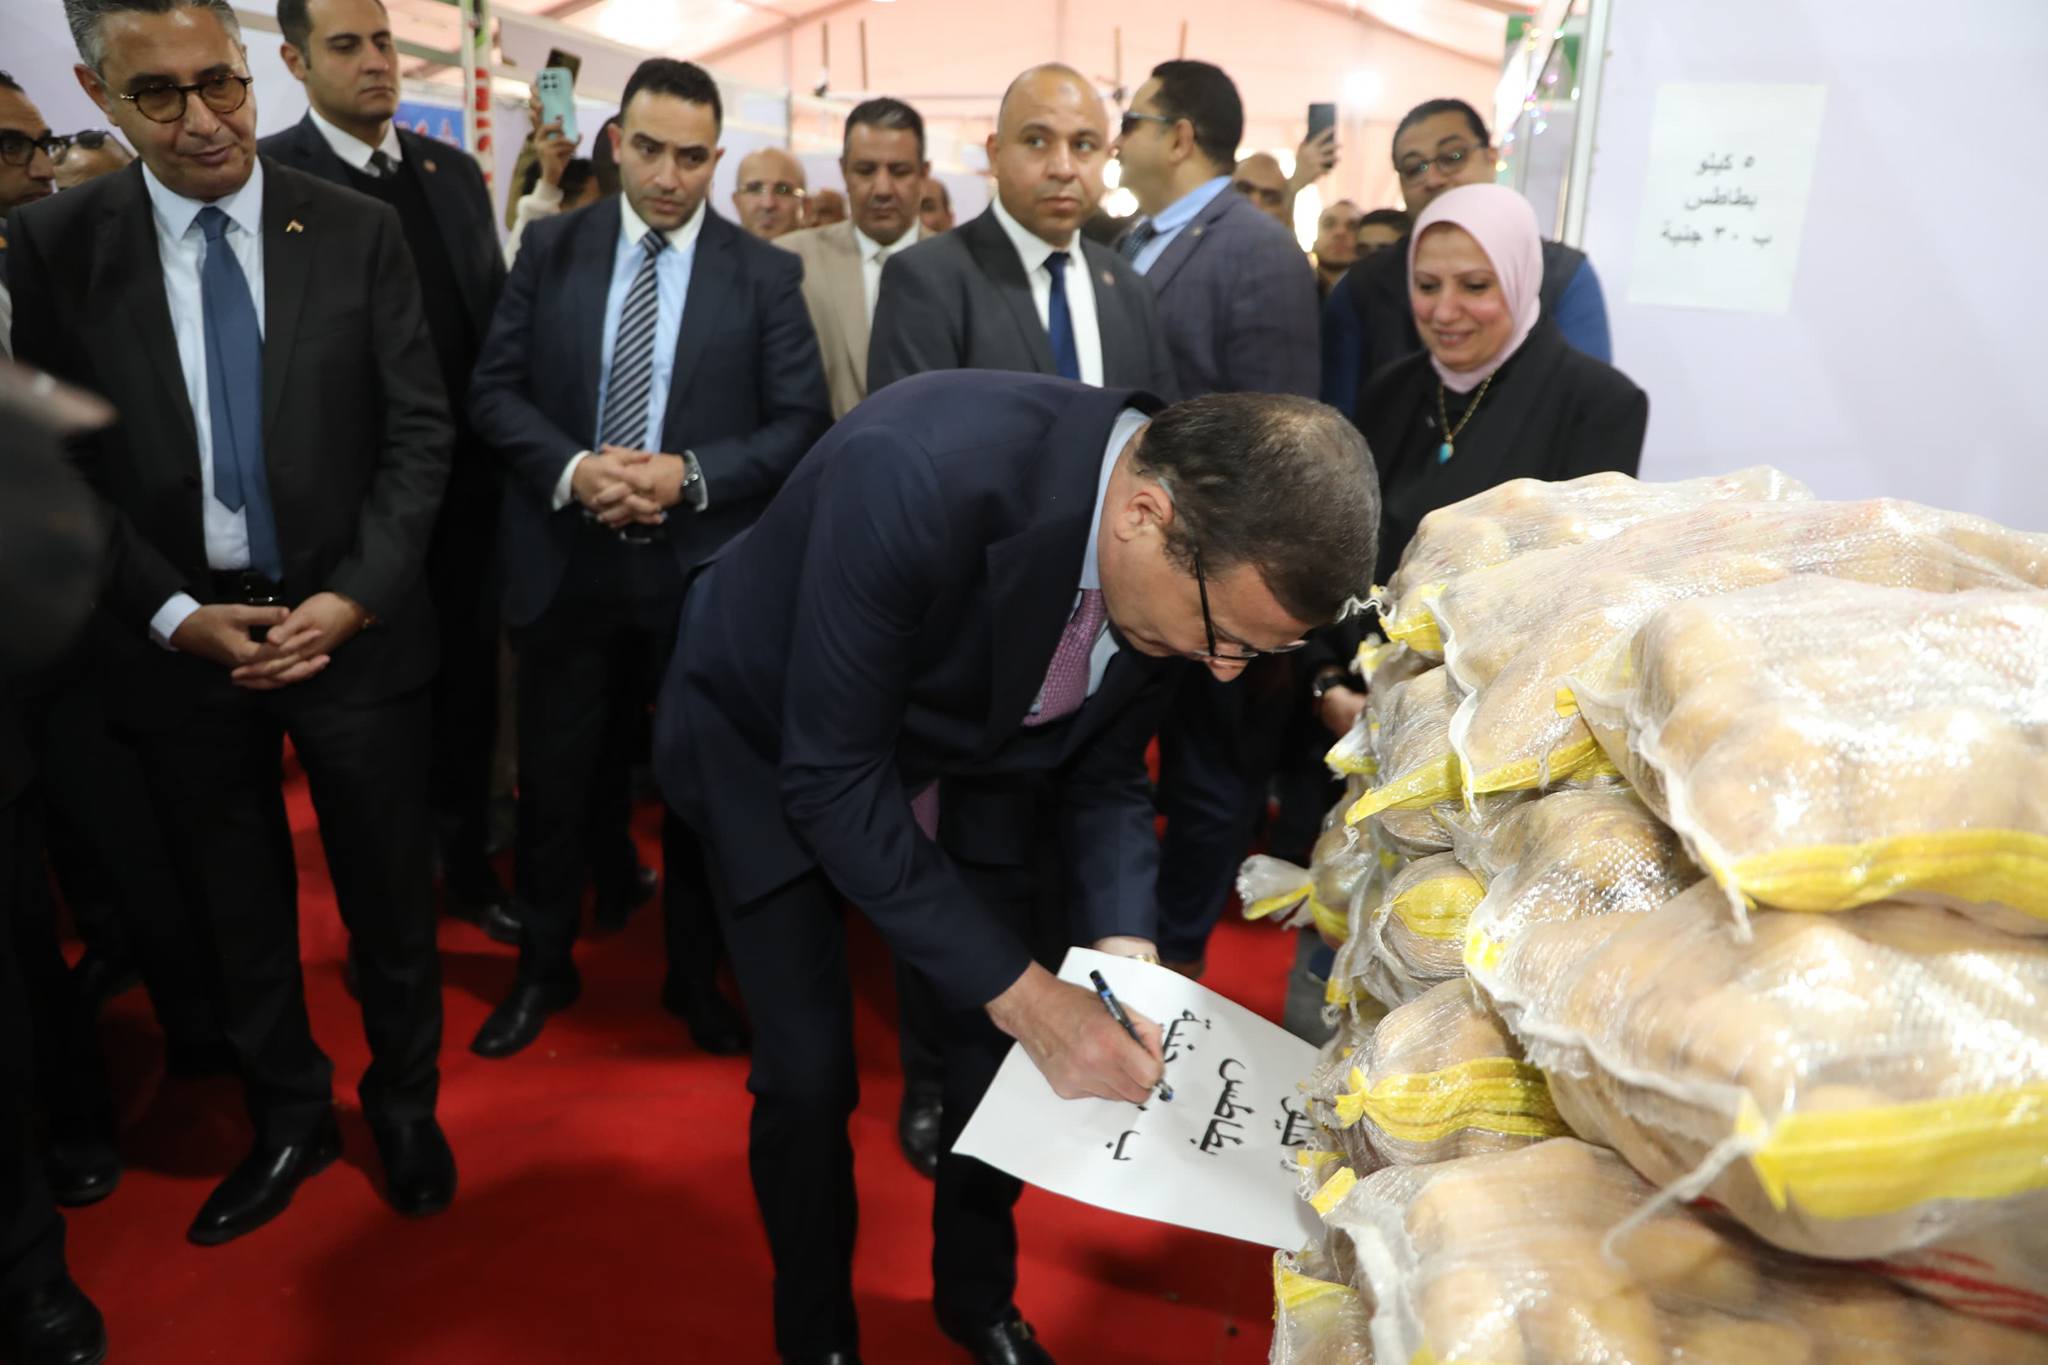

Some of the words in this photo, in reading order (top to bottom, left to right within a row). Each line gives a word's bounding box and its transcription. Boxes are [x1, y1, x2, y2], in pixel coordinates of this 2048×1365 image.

[1696, 152, 1733, 176] كيلو
[1744, 155, 1755, 168] ٥
[1685, 186, 1757, 211] بطاطس
[1190, 1058, 1254, 1156] بطاطس
[1105, 1130, 1141, 1161] ب
